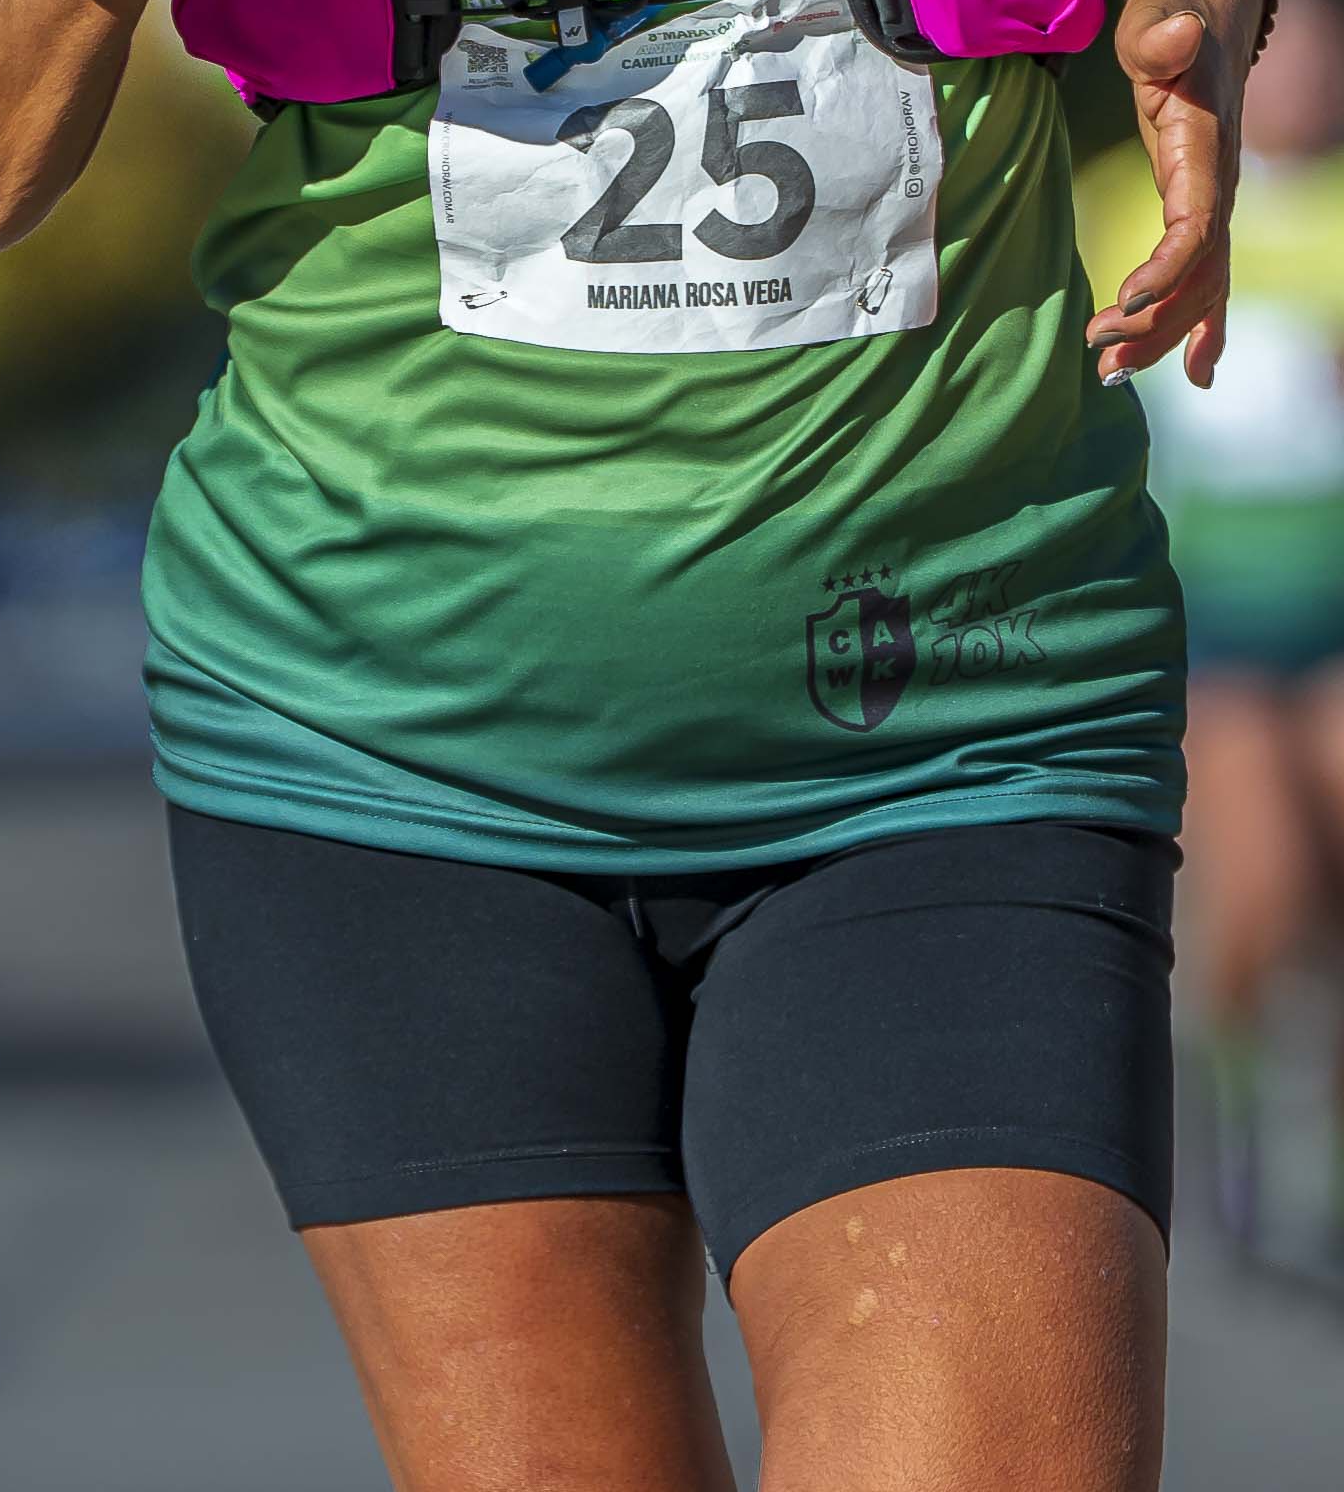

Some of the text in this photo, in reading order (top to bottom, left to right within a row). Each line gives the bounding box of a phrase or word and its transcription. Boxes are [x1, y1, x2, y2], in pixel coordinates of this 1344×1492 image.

[555, 79, 816, 264] 25
[899, 90, 922, 176] @CRONORAV
[587, 277, 793, 310] MARIANA ROSA VEGA
[929, 609, 1047, 685] 10K
